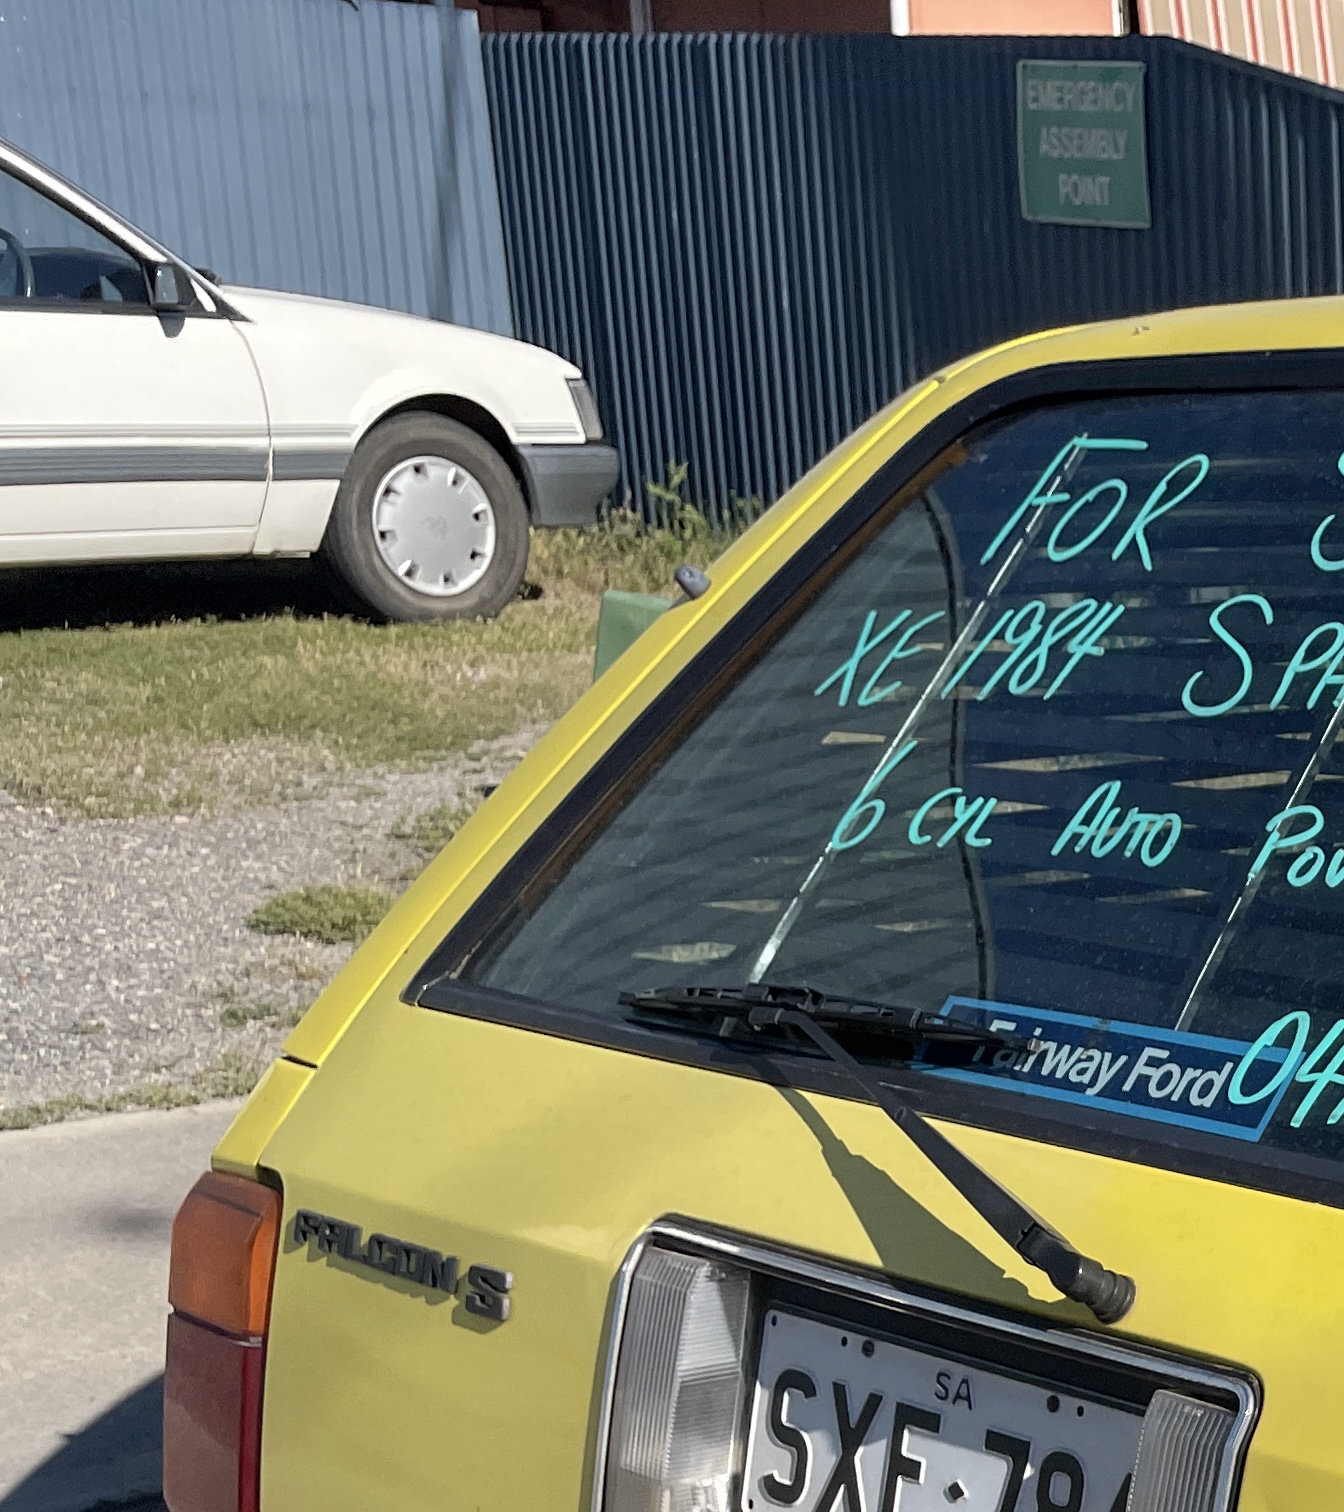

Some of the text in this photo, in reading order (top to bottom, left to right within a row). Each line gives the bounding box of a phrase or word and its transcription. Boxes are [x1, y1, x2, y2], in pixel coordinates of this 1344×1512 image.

[1026, 79, 1136, 112] EMERGENCY
[1039, 125, 1128, 160] ASSEMBLY
[1058, 173, 1110, 206] POINT
[981, 435, 1209, 571] FOR
[940, 599, 1125, 701] 1984
[832, 740, 918, 850] 6
[908, 786, 1000, 848] CYL
[1051, 779, 1183, 868] AUTO
[1123, 1047, 1235, 1108] Ford
[293, 1208, 514, 1322] FALCON S
[934, 1370, 974, 1411] SA
